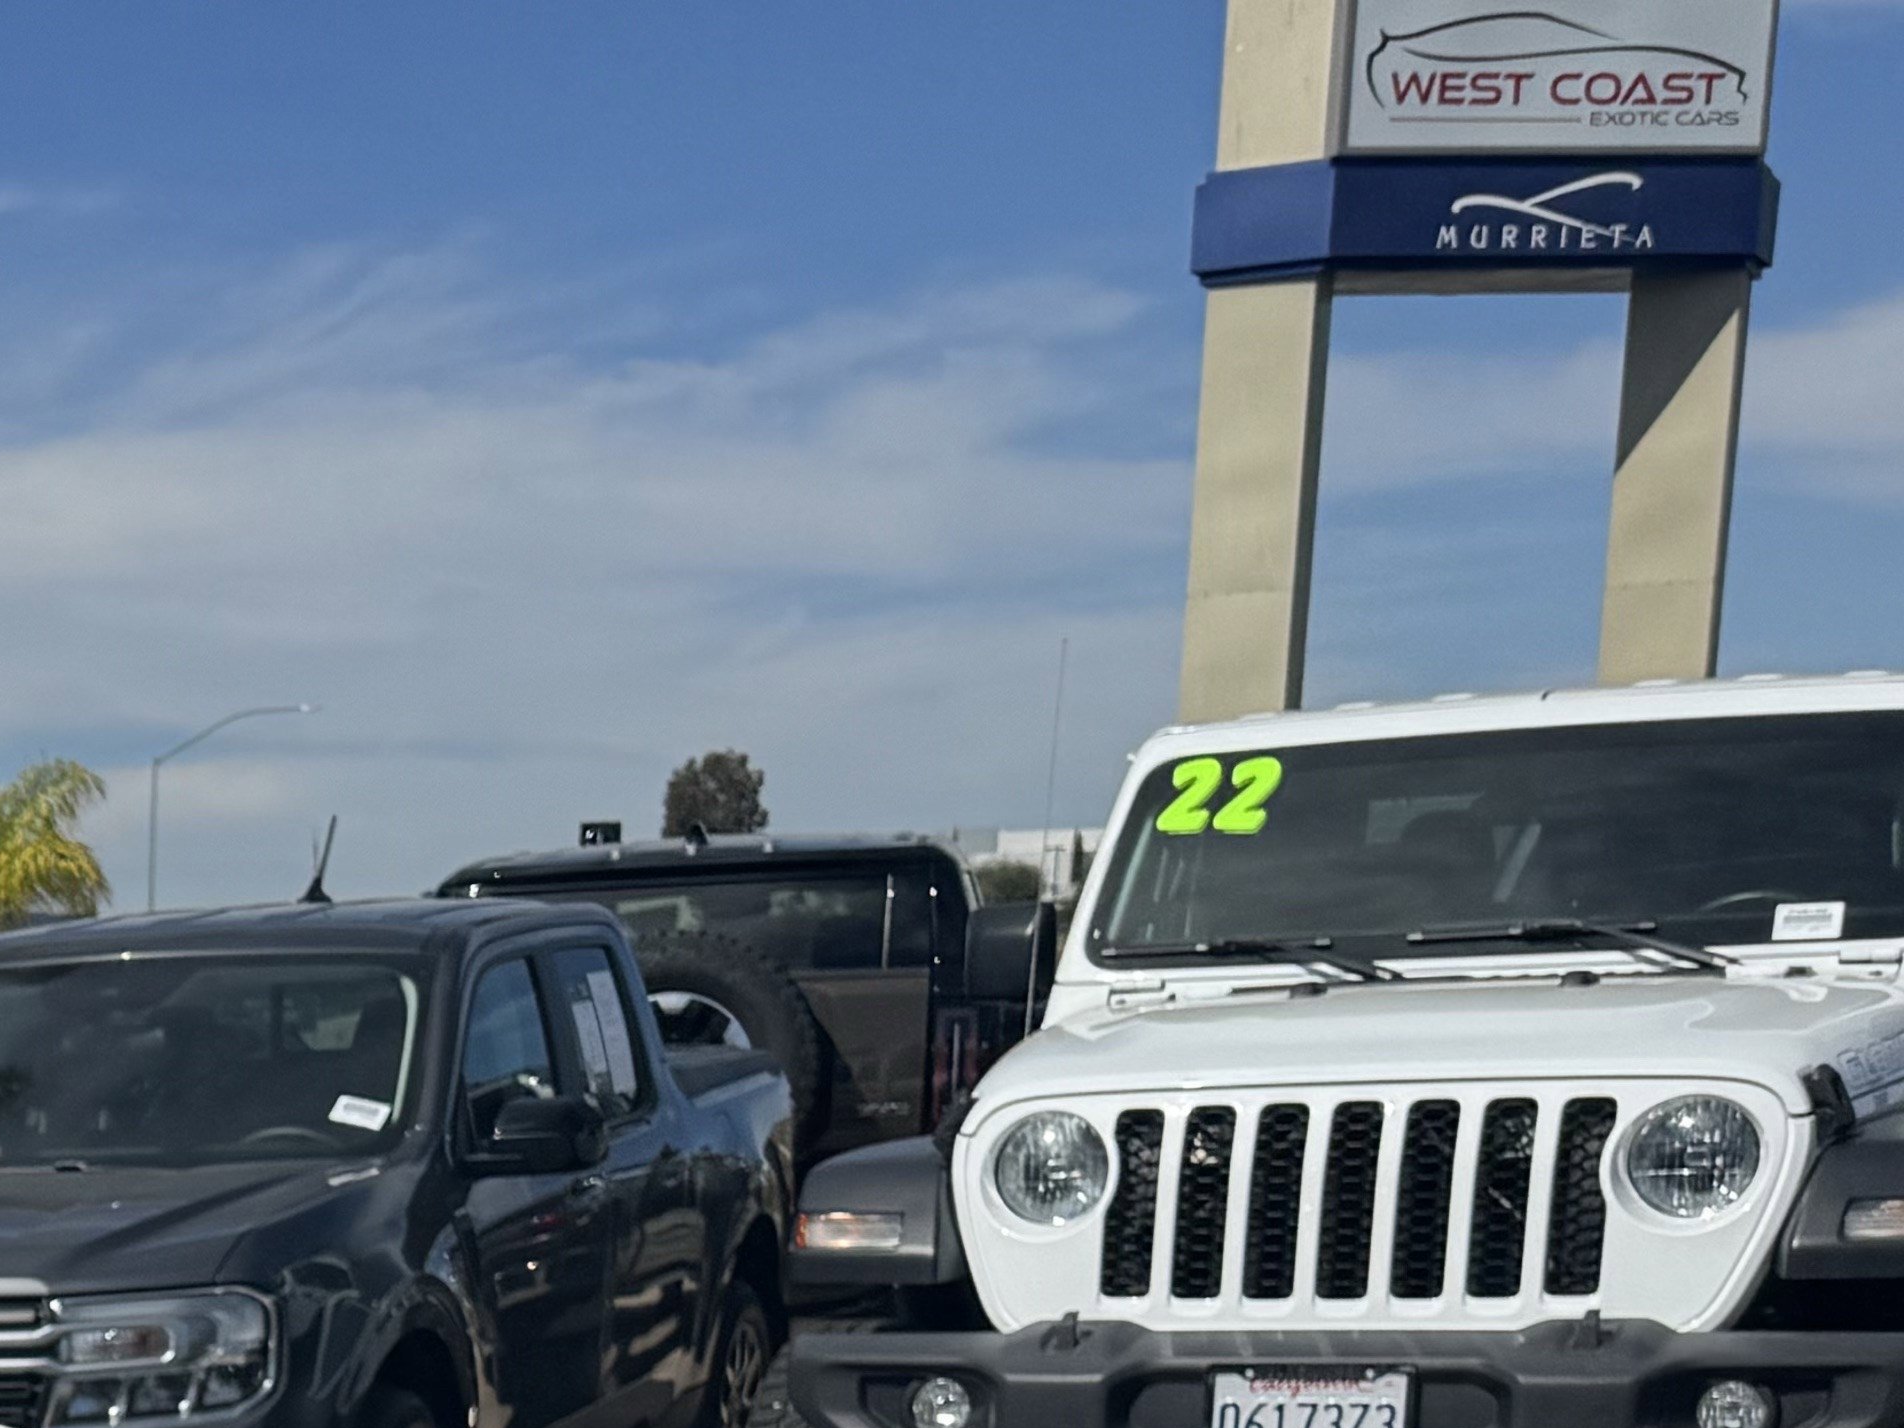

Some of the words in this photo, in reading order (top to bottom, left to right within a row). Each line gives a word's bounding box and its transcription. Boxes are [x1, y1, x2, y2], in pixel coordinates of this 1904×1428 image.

[1391, 72, 1535, 106] WEST
[1550, 72, 1727, 106] COAST
[1589, 110, 1669, 127] EXOTIC
[1674, 110, 1740, 127] CARS
[1436, 225, 1655, 249] MURRIETA
[1155, 756, 1283, 835] 22
